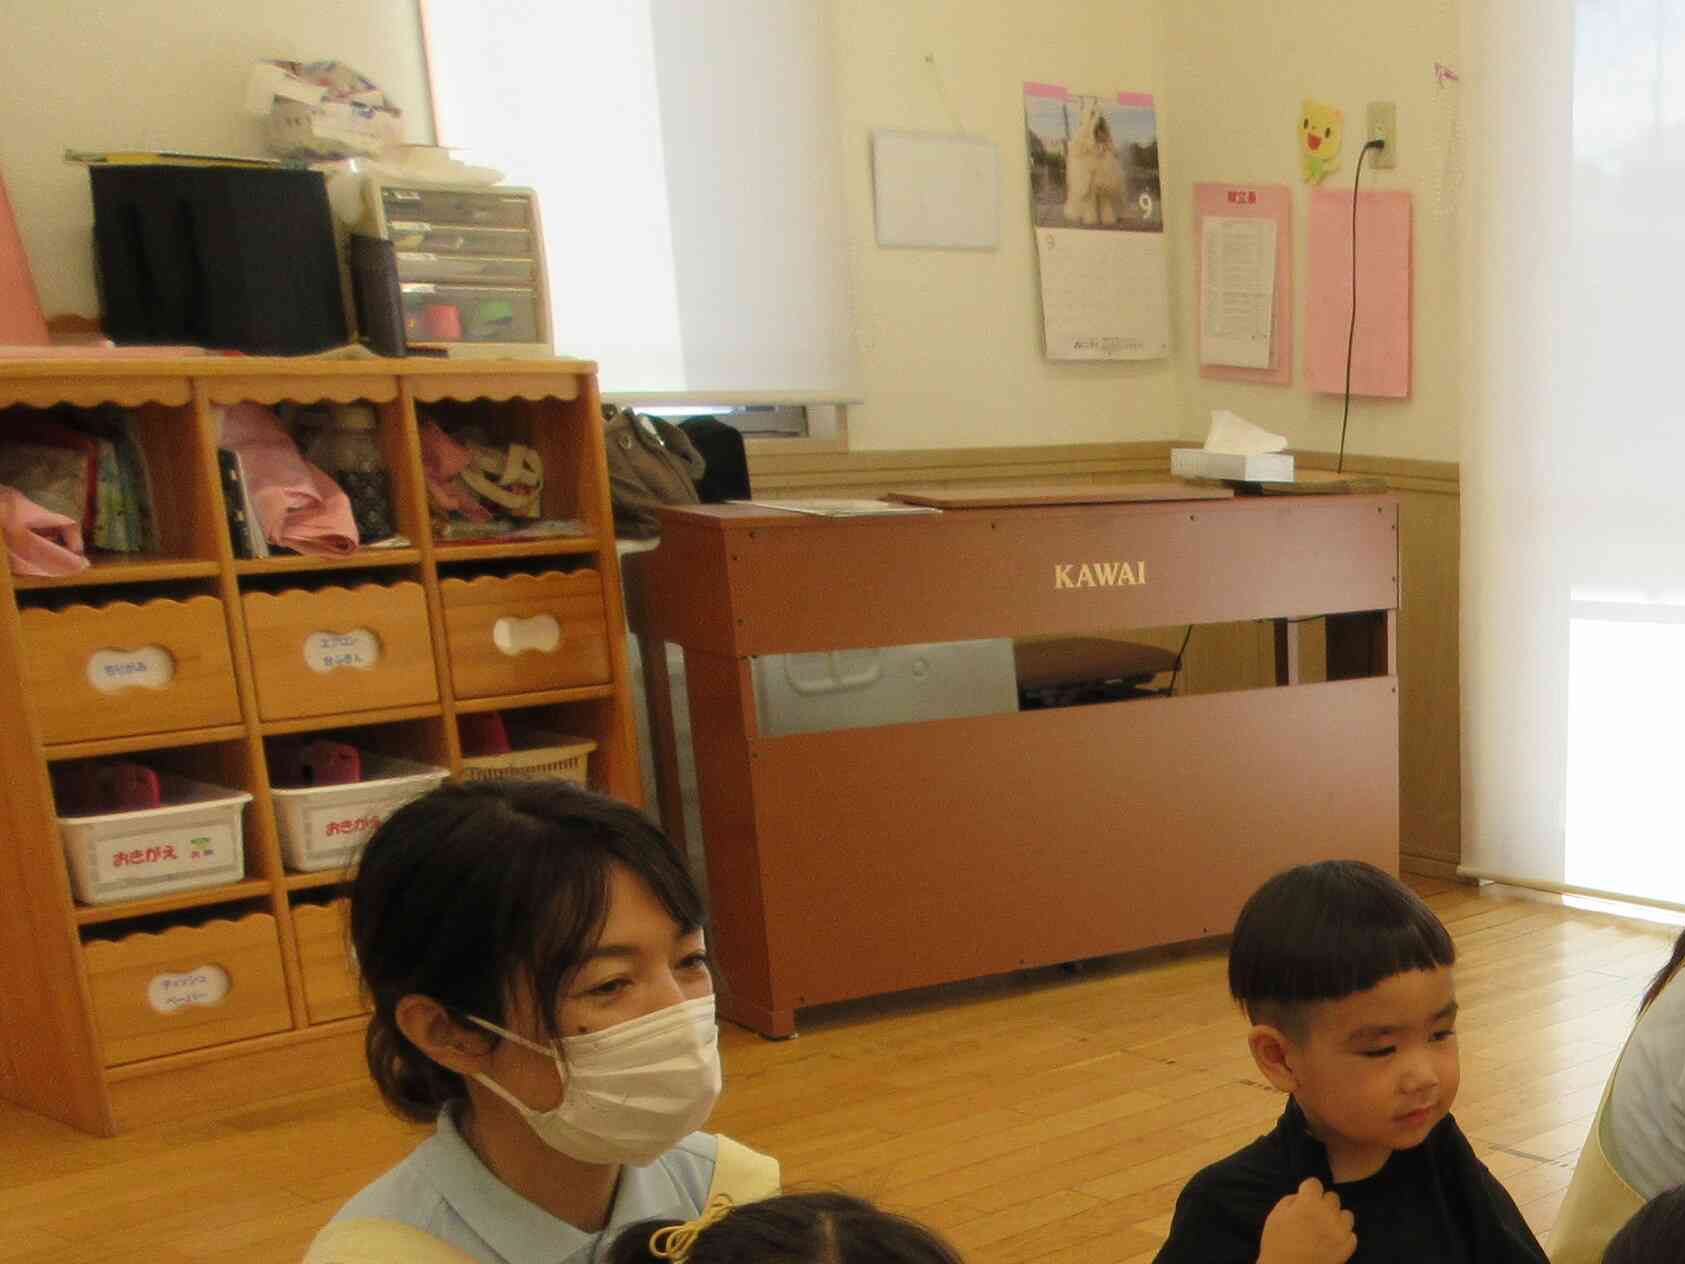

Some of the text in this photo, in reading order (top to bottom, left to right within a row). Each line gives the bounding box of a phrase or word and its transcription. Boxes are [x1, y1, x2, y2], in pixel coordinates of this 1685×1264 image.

[1138, 192, 1153, 219] 9
[1055, 560, 1146, 590] KAWAI
[112, 844, 178, 869] おきがえ
